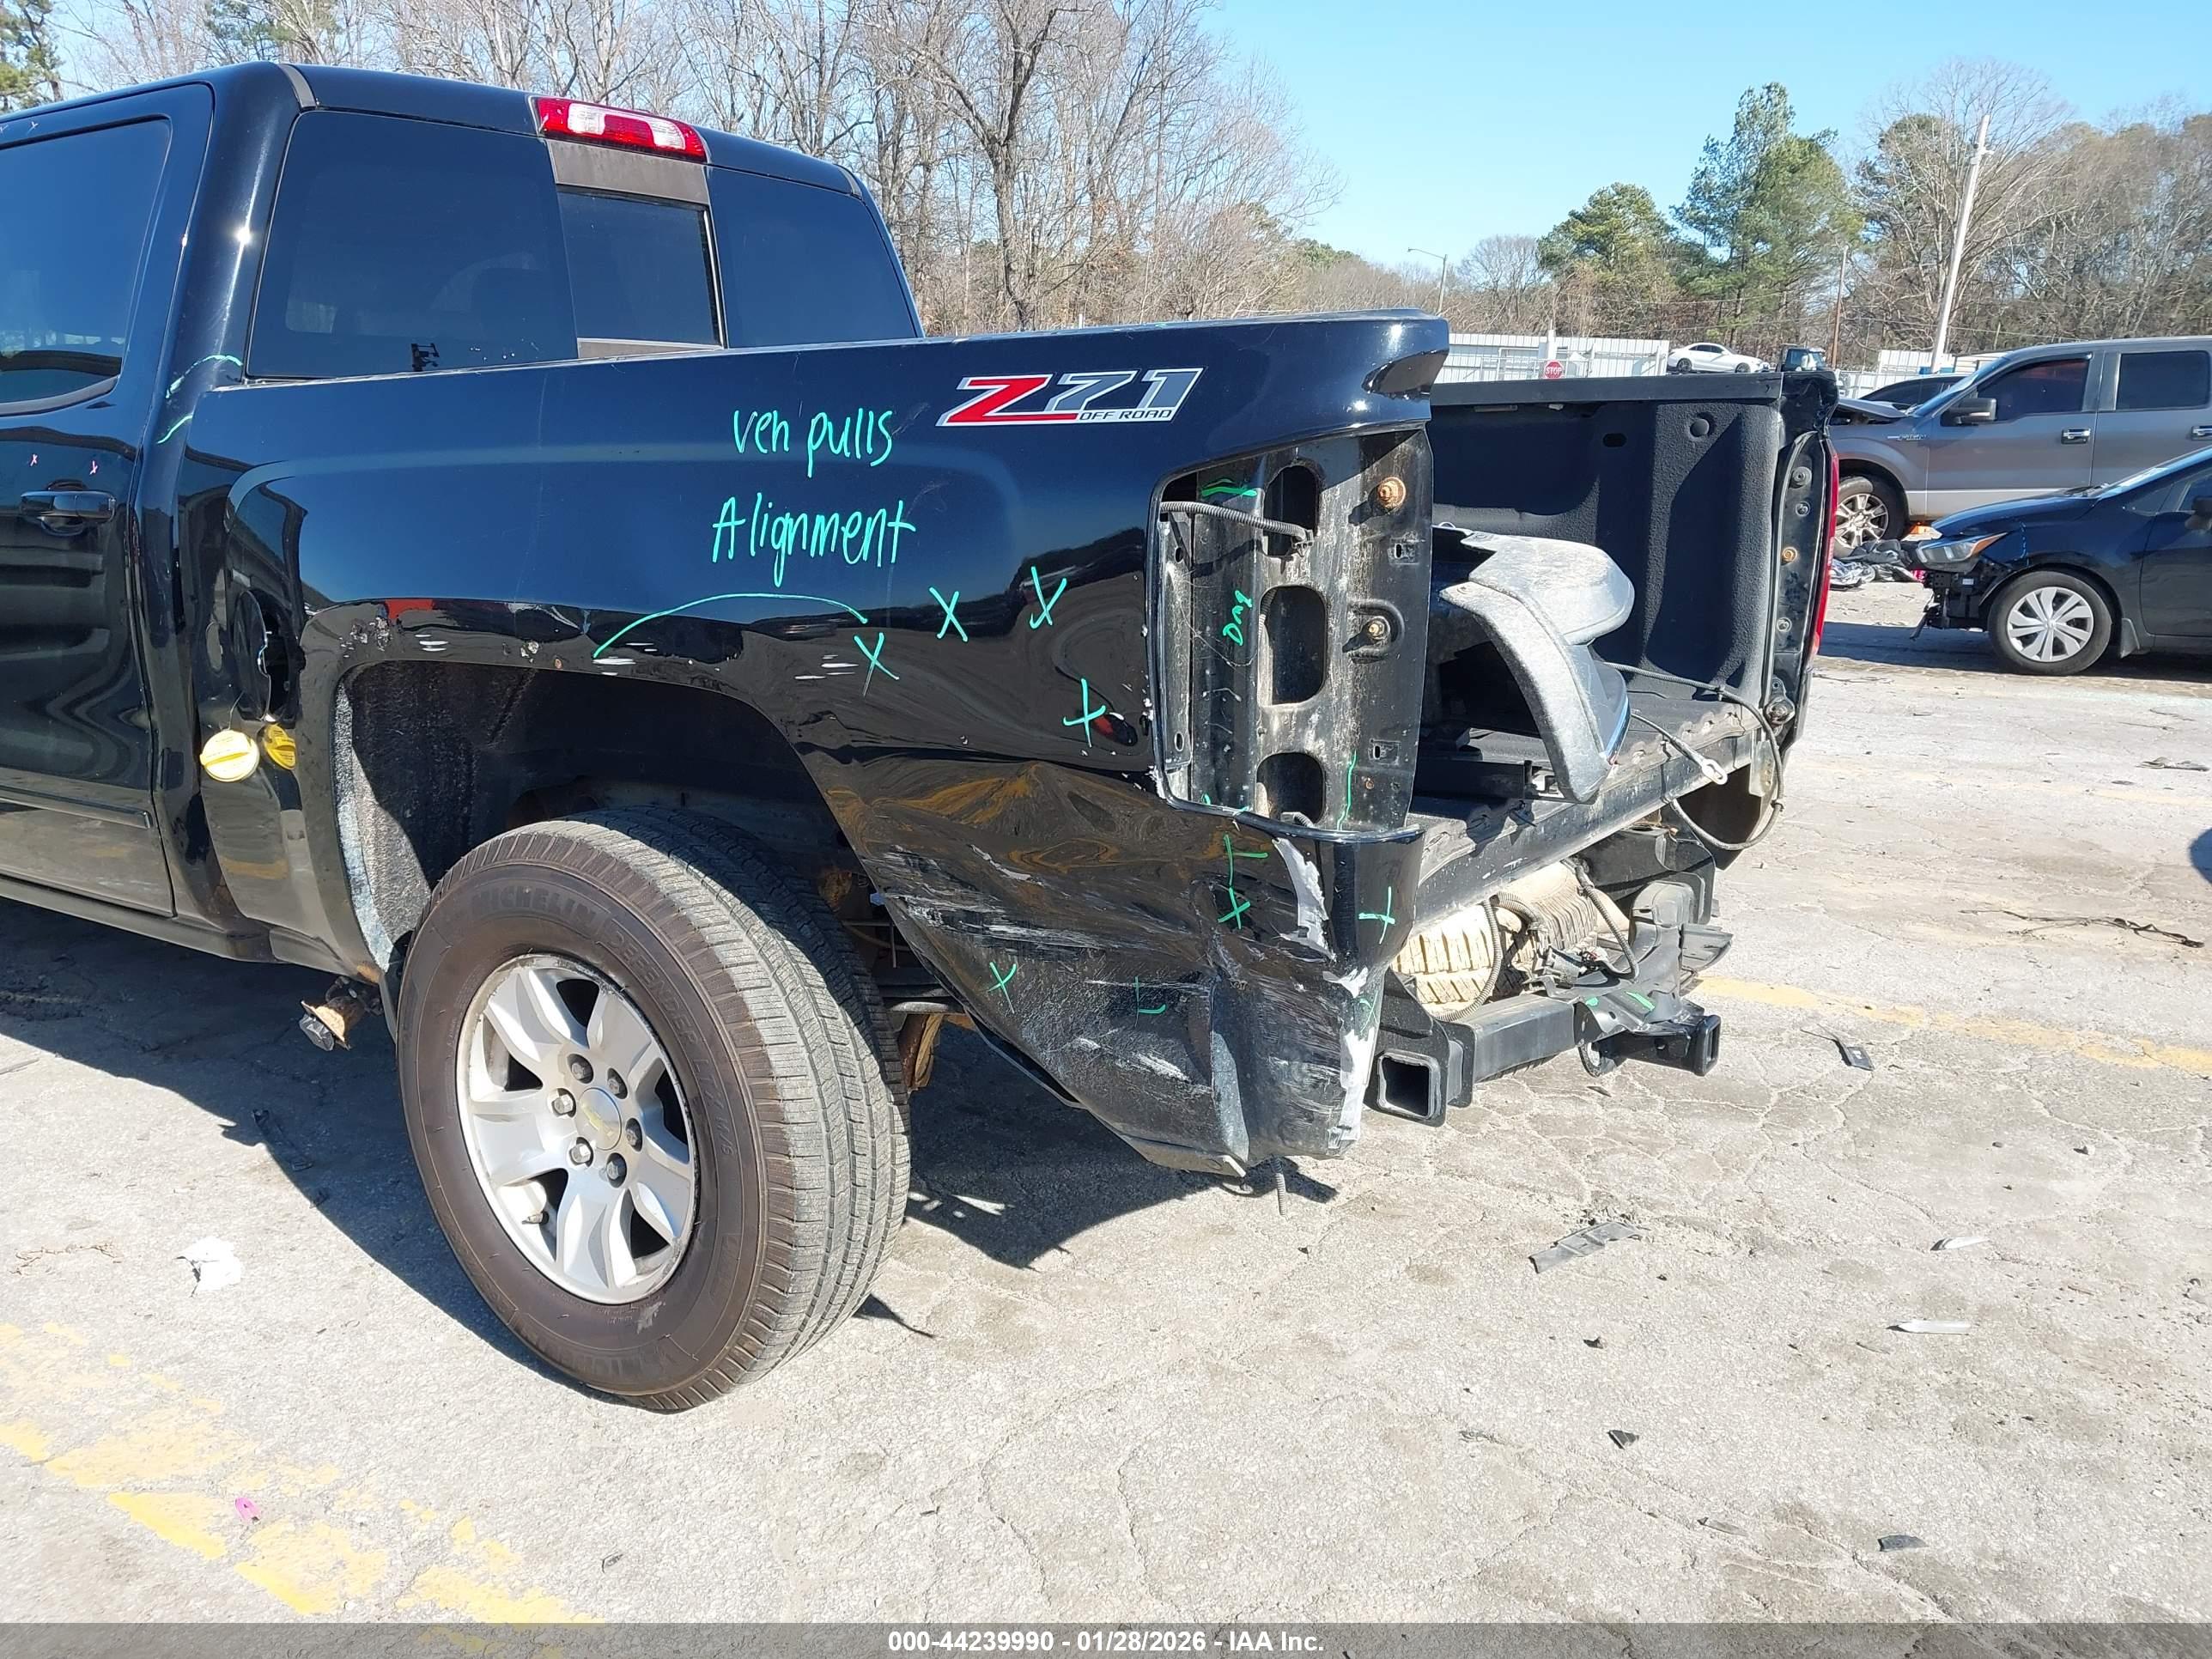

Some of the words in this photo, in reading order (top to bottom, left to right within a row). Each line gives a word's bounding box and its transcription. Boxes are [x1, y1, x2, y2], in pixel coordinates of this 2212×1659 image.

[935, 368, 1204, 427] Z71
[1546, 367, 1562, 375] STOP
[1079, 410, 1115, 422] OFF
[1118, 407, 1173, 421] ROAD
[807, 408, 893, 478] pulls
[712, 492, 916, 587] Alignment
[471, 885, 599, 935] MICHELIN
